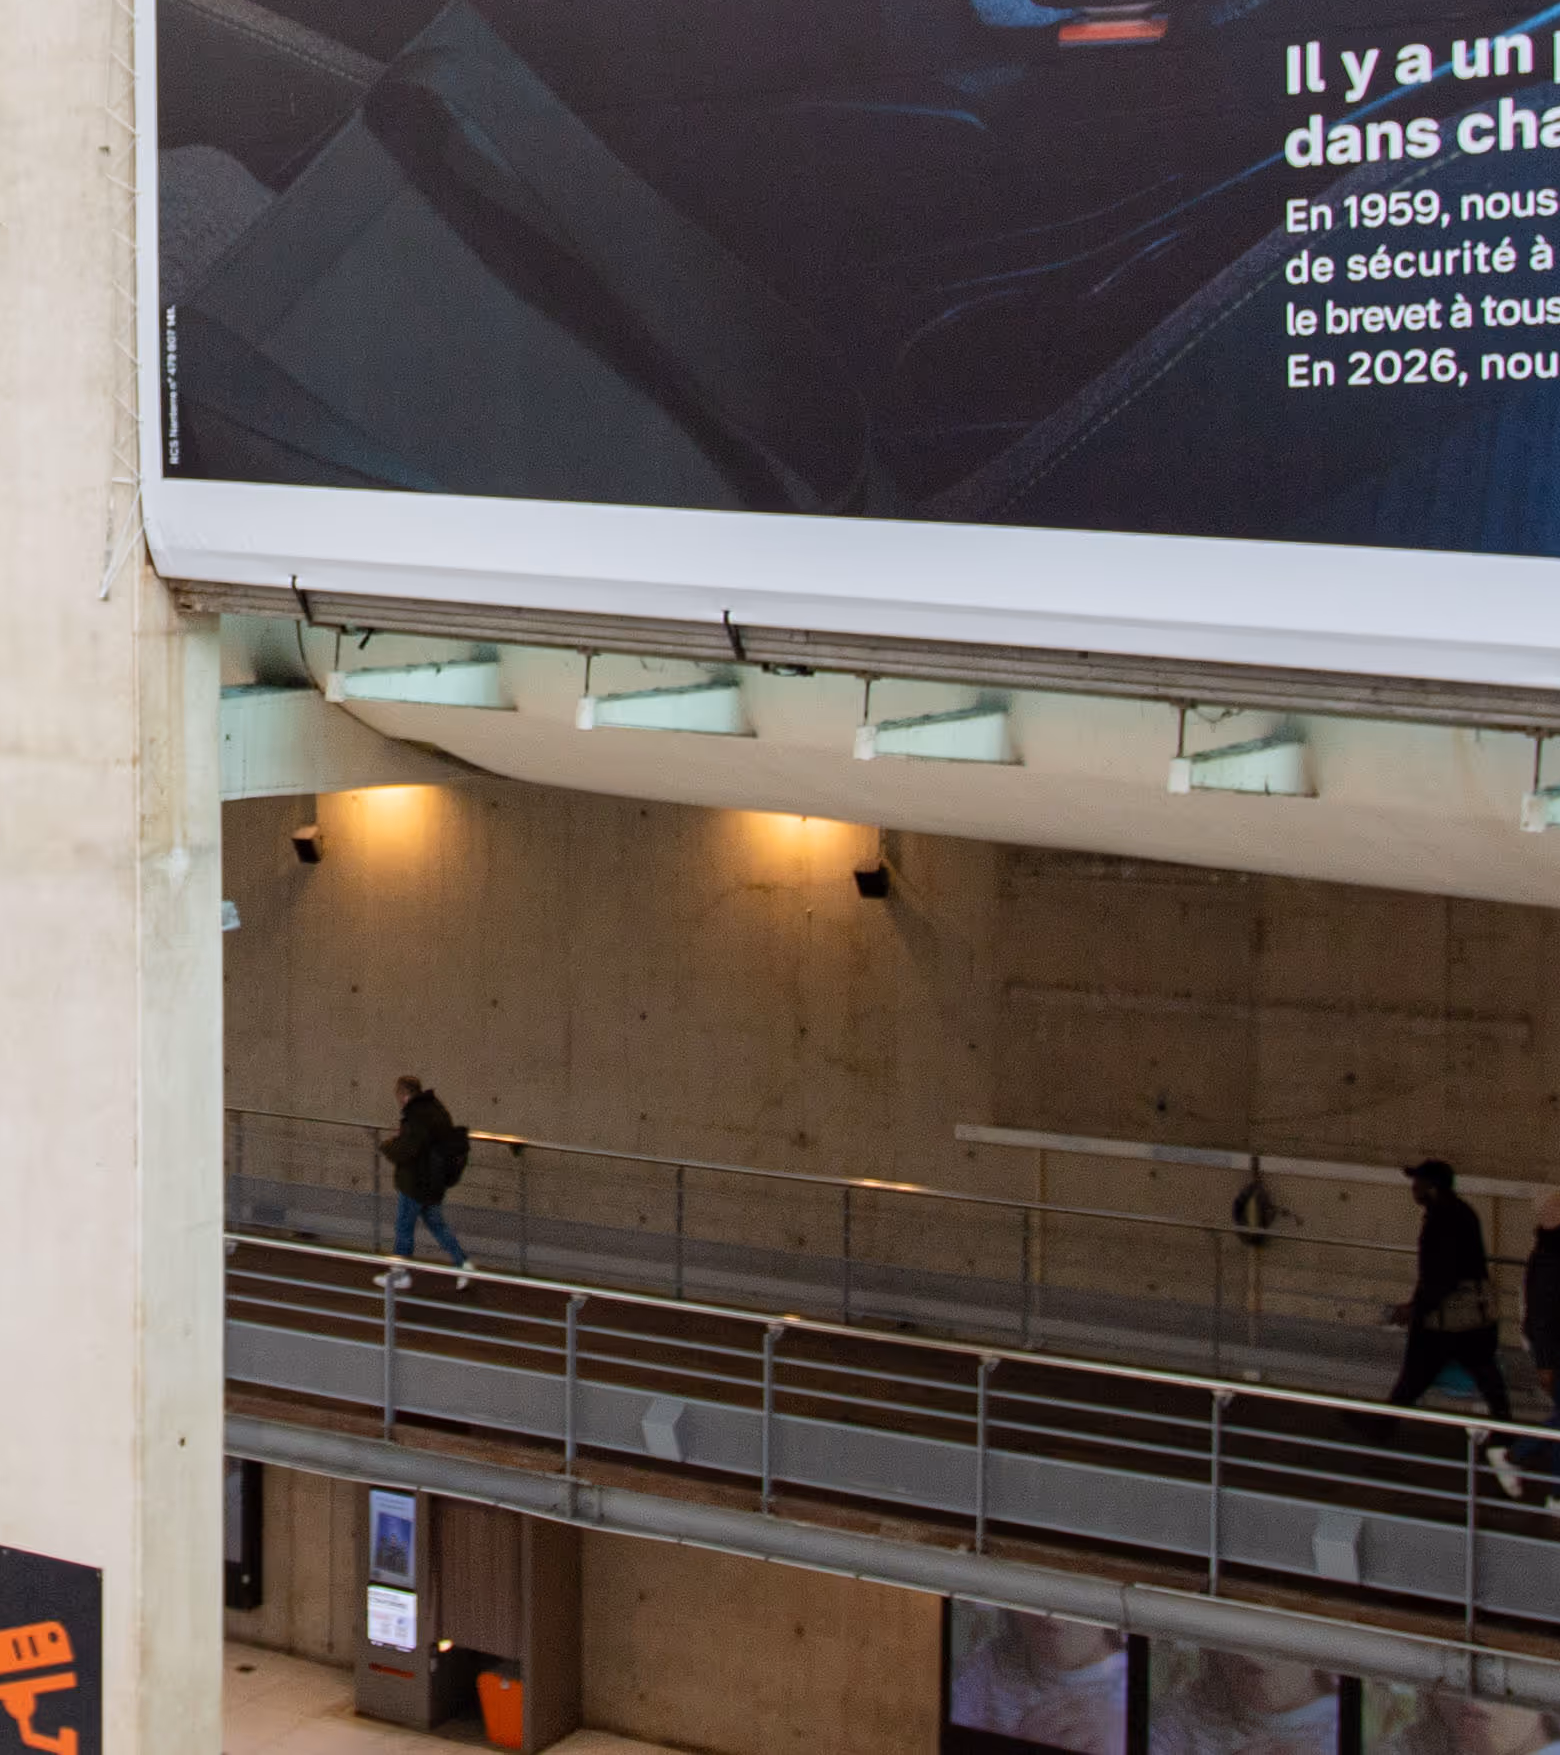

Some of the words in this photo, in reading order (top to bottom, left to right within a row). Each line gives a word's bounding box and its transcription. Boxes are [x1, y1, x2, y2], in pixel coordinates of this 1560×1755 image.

[1287, 42, 1325, 94] Il
[1341, 49, 1378, 102] y
[1396, 44, 1432, 84] a
[1452, 34, 1532, 79] un
[1285, 115, 1440, 167] dans
[1287, 199, 1332, 232] En
[1344, 190, 1449, 228] 1959,
[1461, 189, 1558, 220] nous
[1286, 250, 1334, 284] de
[1348, 237, 1516, 280] sécurité
[1530, 235, 1553, 270] à
[1287, 303, 1317, 335] le
[1327, 299, 1441, 334] brevet
[1450, 294, 1472, 328] à
[1288, 355, 1334, 387] En
[1349, 348, 1467, 386] 2026,
[168, 439, 180, 465] RCS
